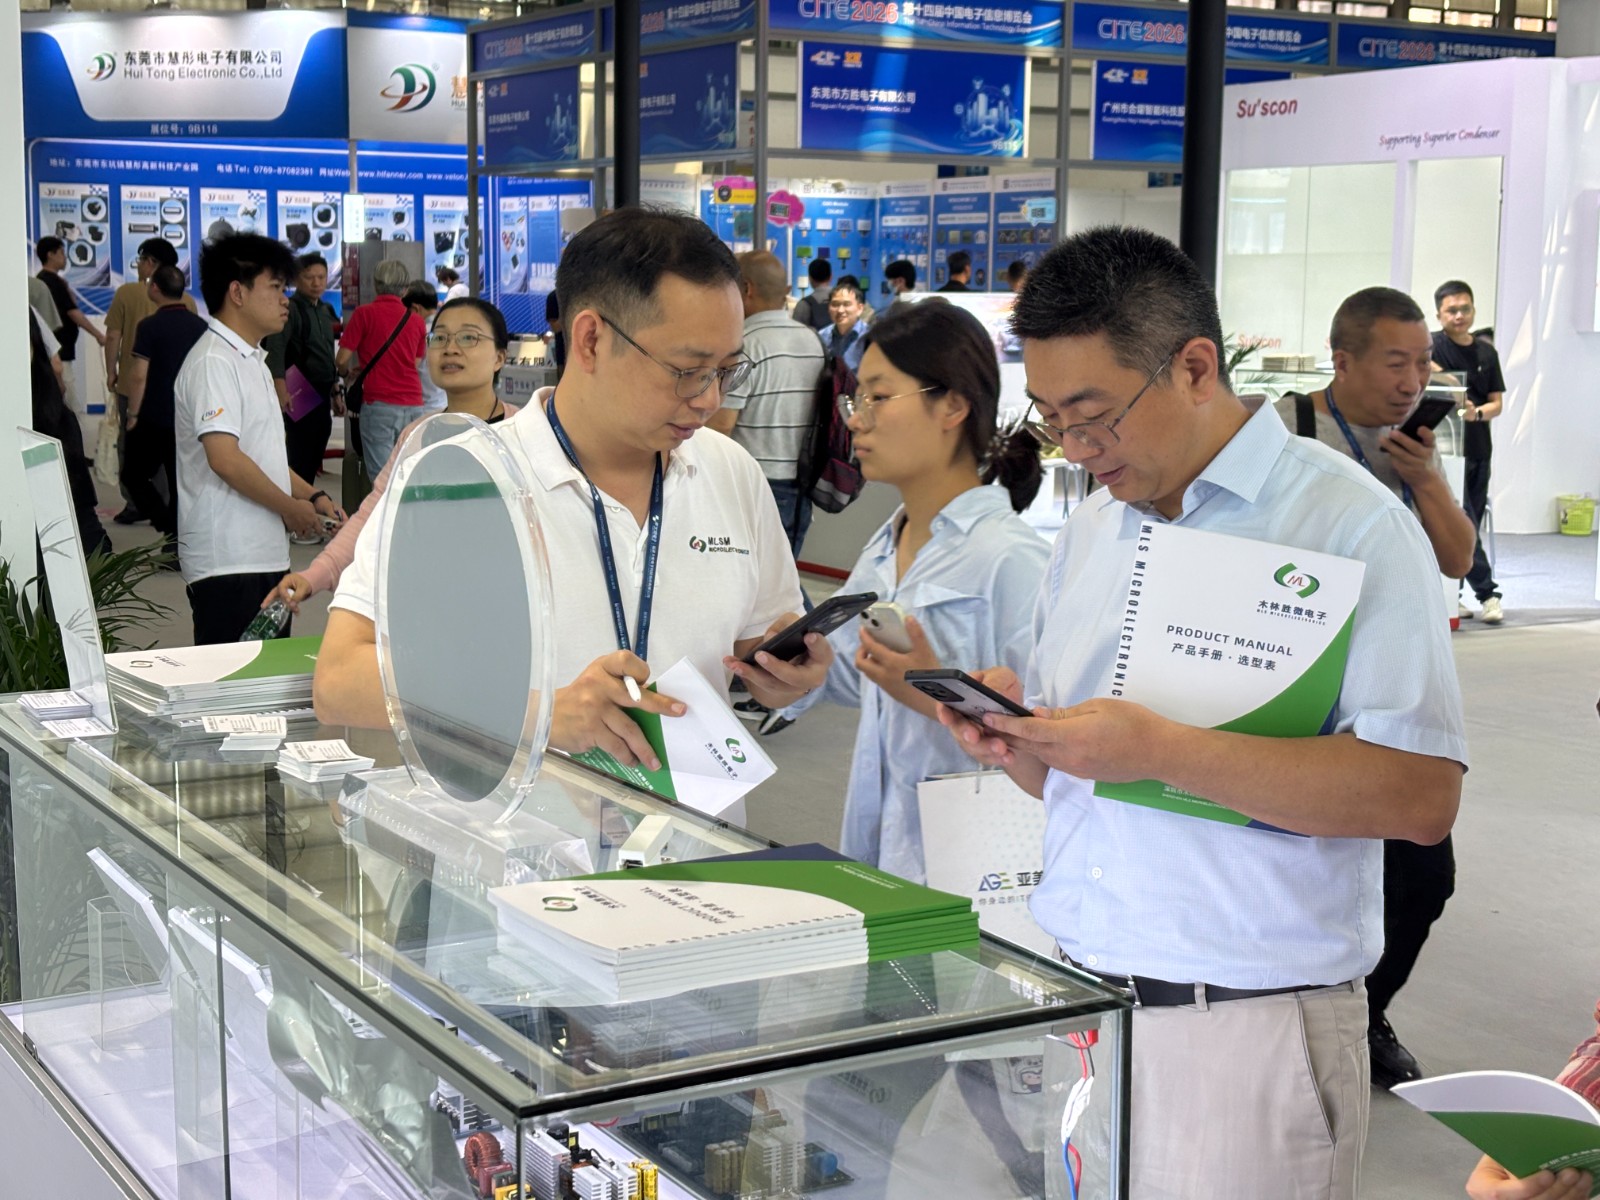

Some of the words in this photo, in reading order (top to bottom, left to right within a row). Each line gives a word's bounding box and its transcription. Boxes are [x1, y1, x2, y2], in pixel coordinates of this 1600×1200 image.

[798, 0, 899, 24] CITE2026
[903, 2, 1033, 25] 第十四届中国电子信息博览会
[1098, 18, 1185, 44] CITE2026
[124, 49, 283, 66] 东莞市慧彤电子有限公司
[124, 66, 145, 79] Hui
[146, 66, 175, 81] Tong
[178, 66, 237, 80] Electronic
[811, 86, 917, 104] 东莞市方胜电子有限公司
[1236, 97, 1298, 120] Su'scon
[708, 536, 731, 546] MLSM
[1138, 524, 1153, 553] MLS
[1257, 600, 1328, 621] 木林胜微电子
[1166, 624, 1231, 646] PRODUCT
[1233, 637, 1294, 658] MANUAL
